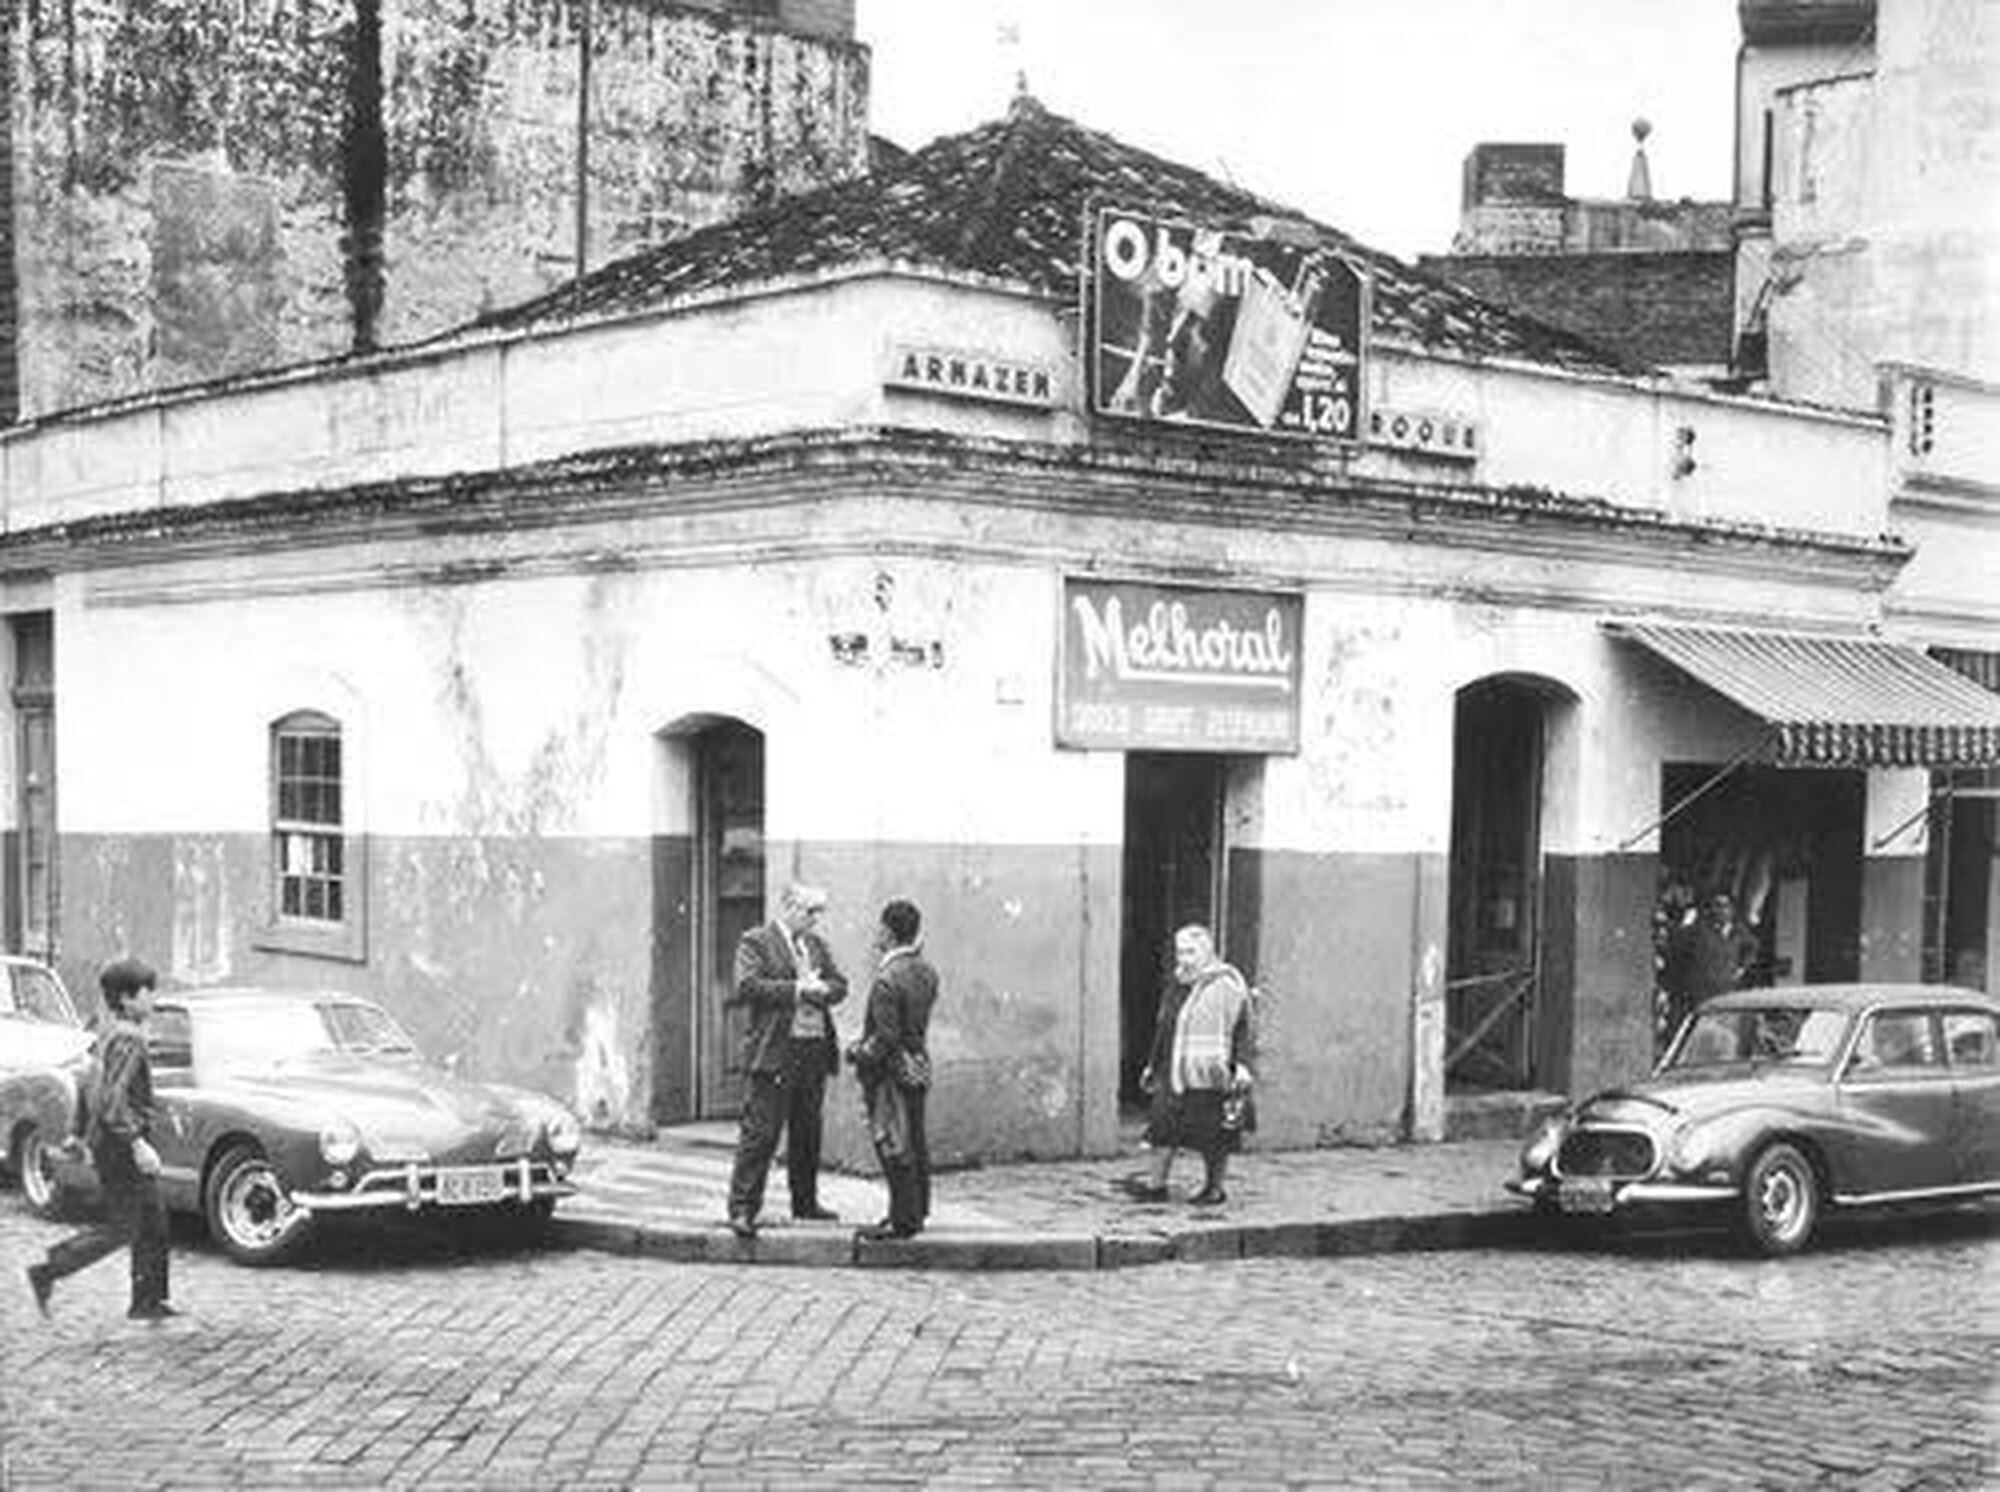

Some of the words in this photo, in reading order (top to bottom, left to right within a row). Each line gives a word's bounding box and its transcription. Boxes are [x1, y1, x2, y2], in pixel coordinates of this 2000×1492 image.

[1105, 219, 1149, 281] O
[902, 353, 1049, 398] ARMAZEM
[1073, 595, 1291, 678] Melhoral
